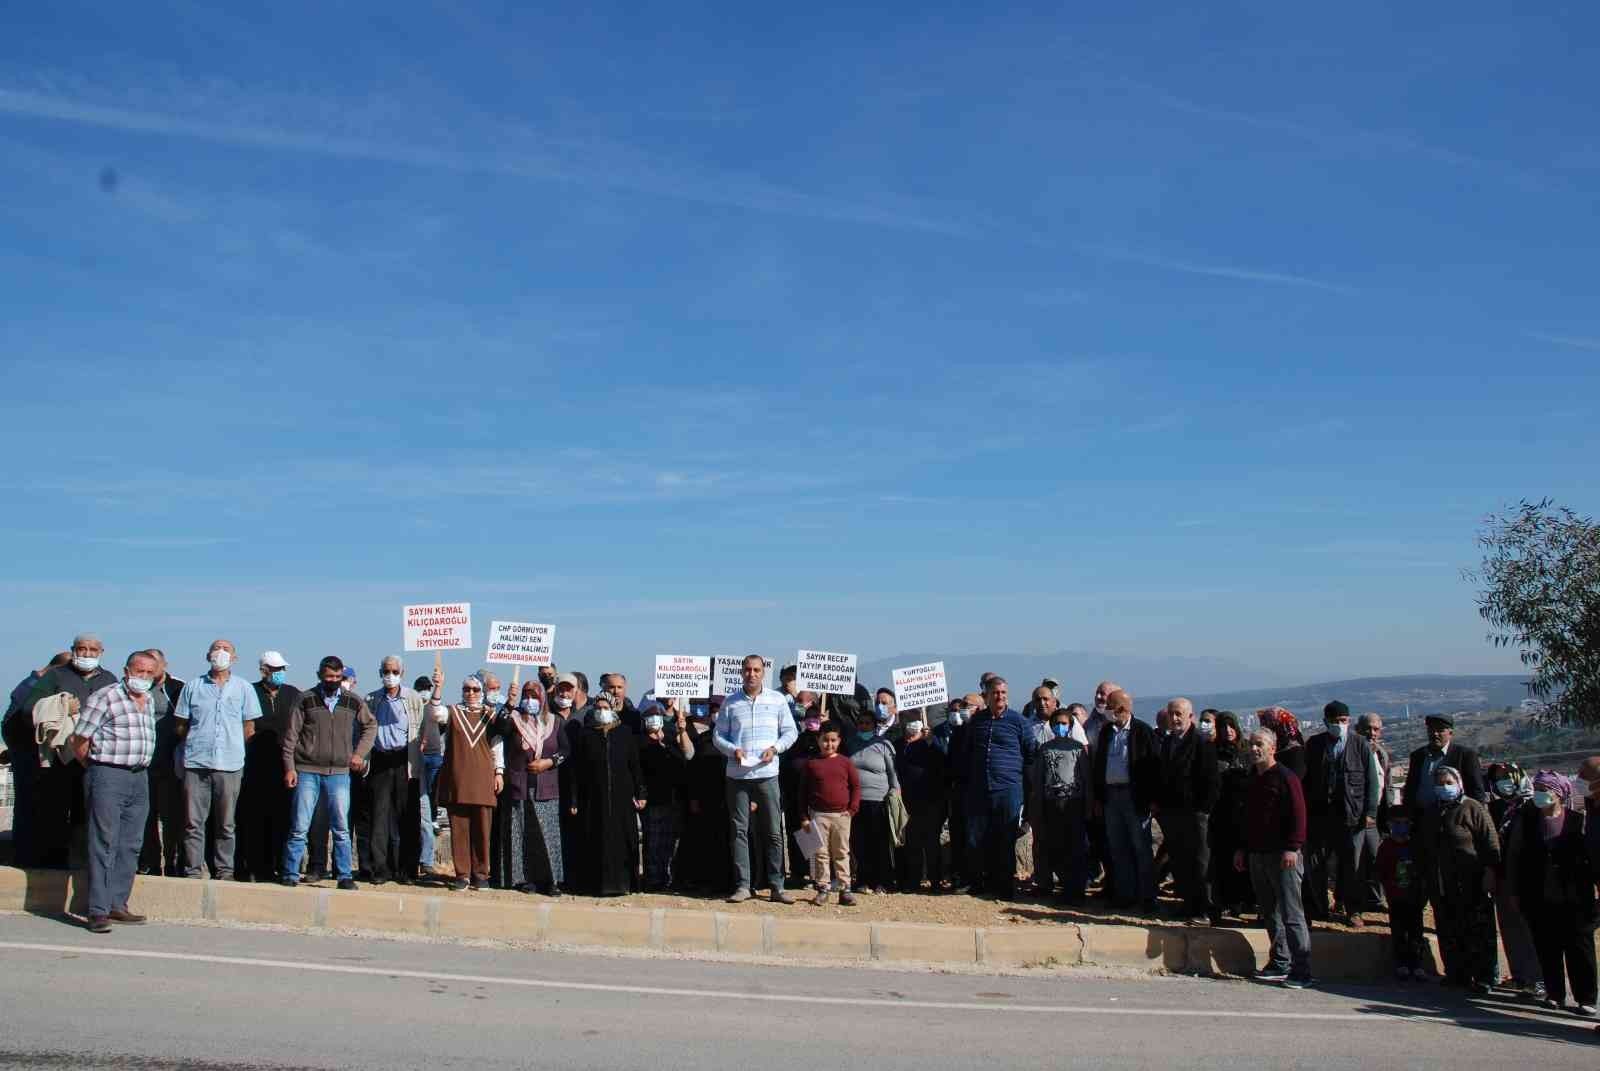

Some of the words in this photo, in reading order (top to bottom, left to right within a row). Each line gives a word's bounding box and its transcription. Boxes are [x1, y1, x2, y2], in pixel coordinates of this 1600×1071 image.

[408, 607, 432, 616] SAYIN
[435, 606, 463, 615] KEMAL
[408, 616, 467, 627] KILIÇDAROĞLU
[422, 628, 453, 637] ADALET
[416, 638, 460, 648] İSTİYORUZ
[806, 653, 826, 661] SAYIN
[823, 664, 854, 672] ERDOĞAN
